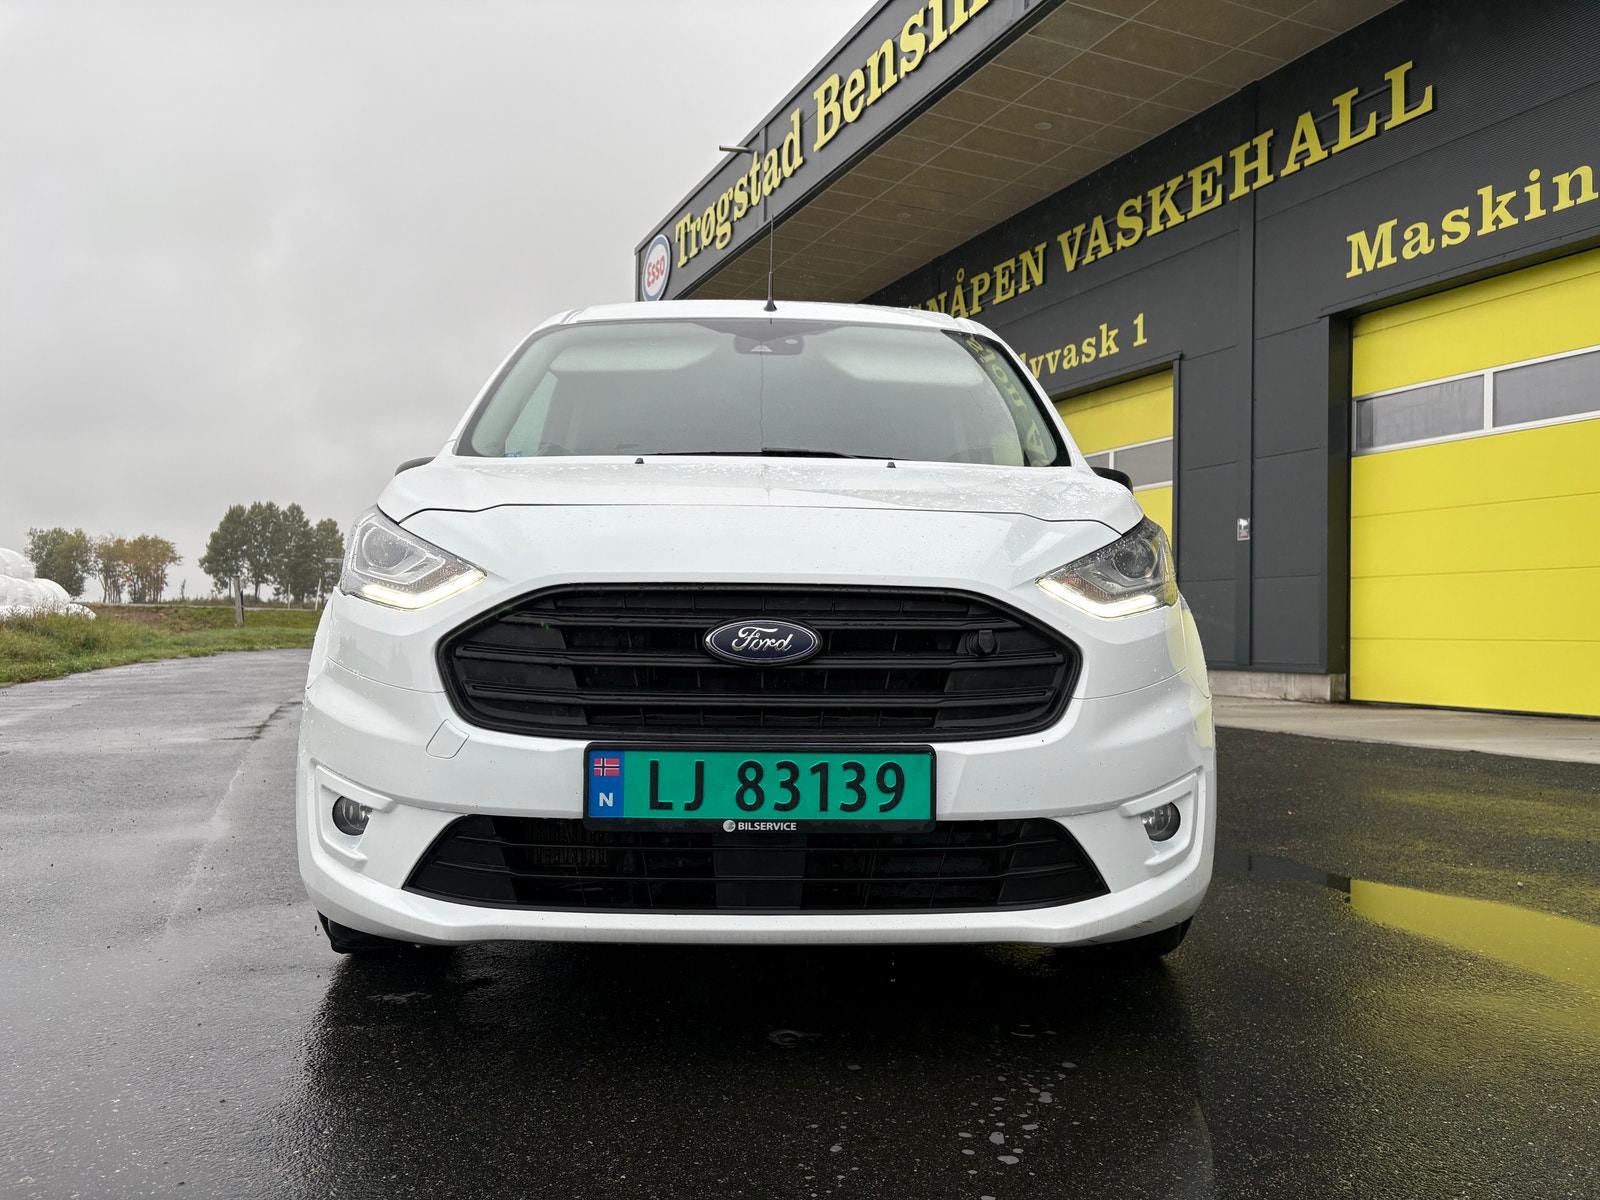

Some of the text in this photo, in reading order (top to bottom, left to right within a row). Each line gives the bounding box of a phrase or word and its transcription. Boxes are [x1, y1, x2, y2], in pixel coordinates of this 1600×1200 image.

[675, 107, 803, 268] Trøgstad
[1056, 60, 1434, 274] VASKEHALL
[1345, 164, 1600, 279] Maskin
[1133, 313, 1148, 348] 1
[731, 626, 793, 652] Ford
[598, 792, 614, 807] N
[650, 759, 905, 812] LJ 83139
[737, 821, 798, 832] BILSERVICE
